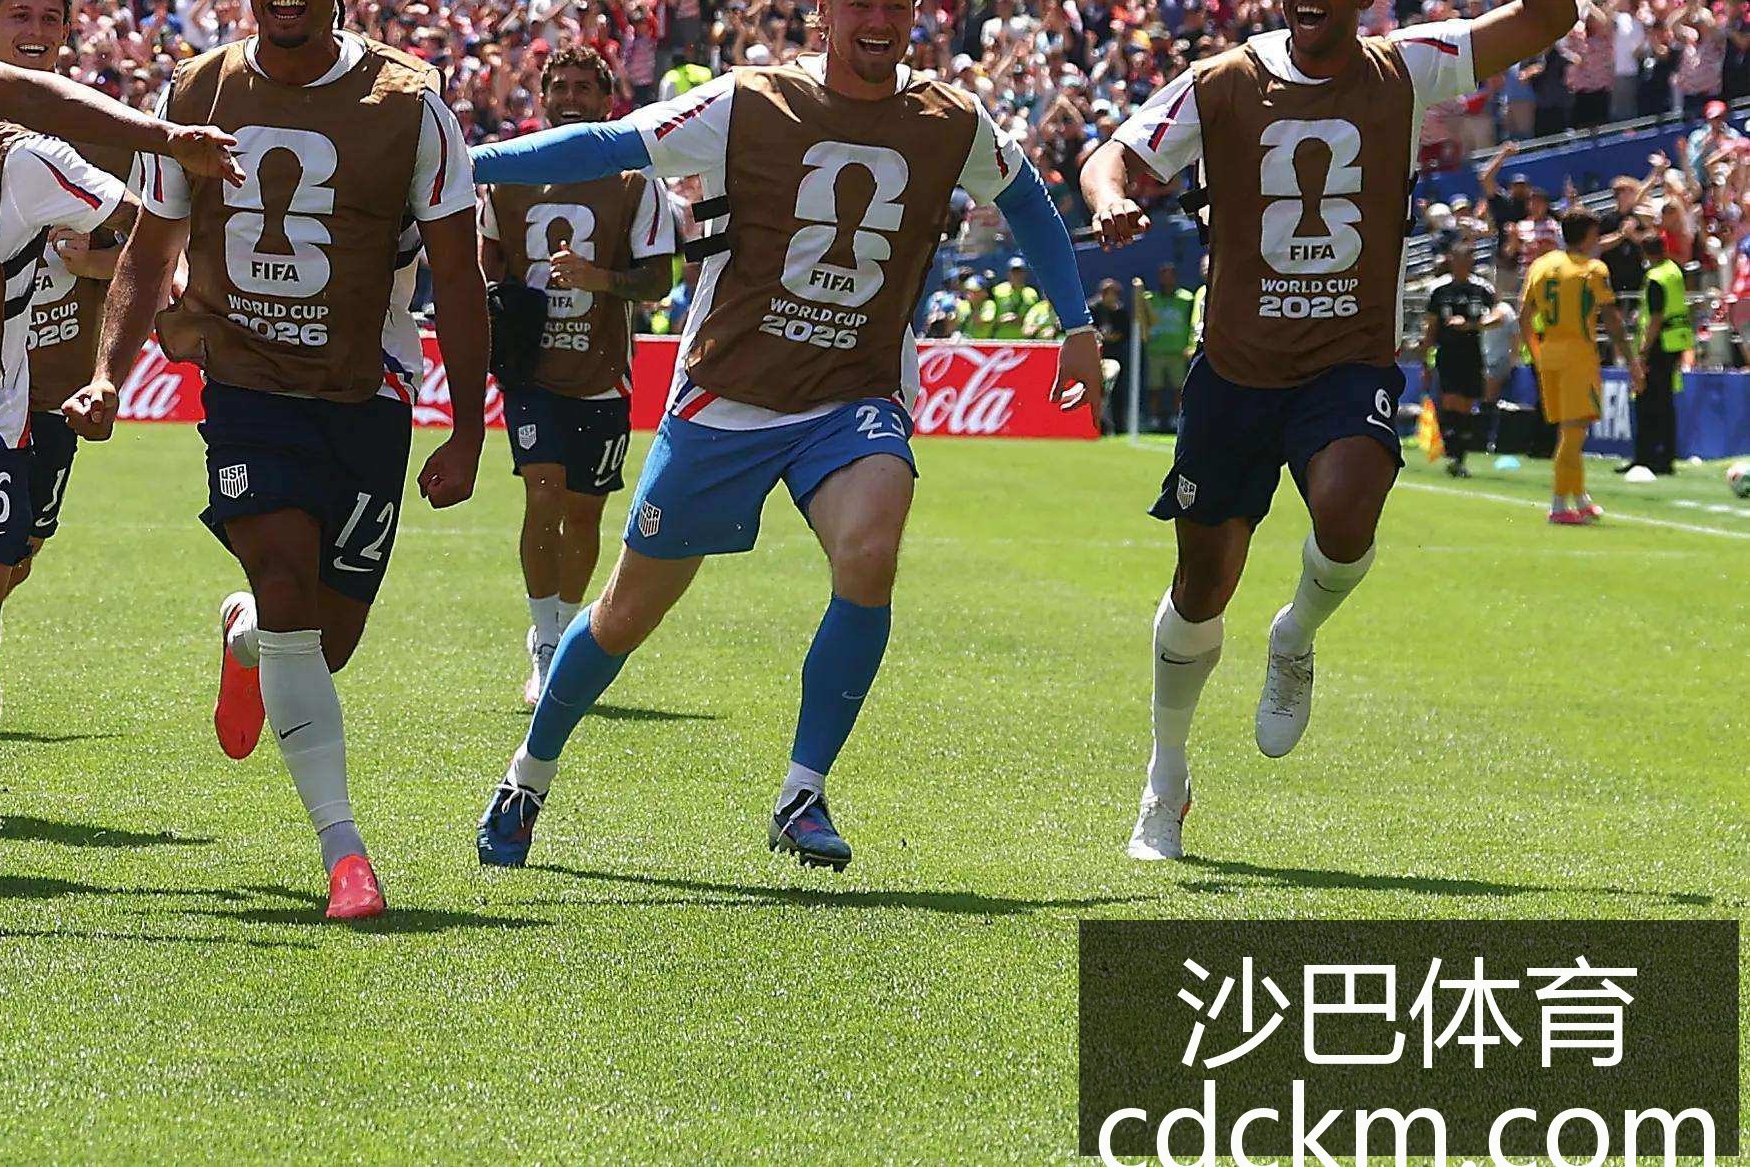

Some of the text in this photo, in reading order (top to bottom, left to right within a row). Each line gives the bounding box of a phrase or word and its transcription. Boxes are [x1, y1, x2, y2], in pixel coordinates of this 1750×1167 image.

[1290, 245, 1336, 260] FIFA
[251, 261, 299, 282] FIFA
[809, 270, 855, 293] FIFA
[1261, 278, 1359, 293] WORLD CUP
[51, 302, 78, 320] CUP
[227, 294, 329, 319] WORLD CUP
[770, 297, 868, 328] WORLD CUP
[1259, 295, 1359, 319] 2026
[27, 318, 79, 350] 026
[566, 322, 591, 333] CUP
[759, 314, 858, 350] 2026
[540, 333, 589, 351] 026
[1375, 388, 1392, 419] 6
[596, 434, 626, 476] 10
[335, 492, 394, 561] 12
